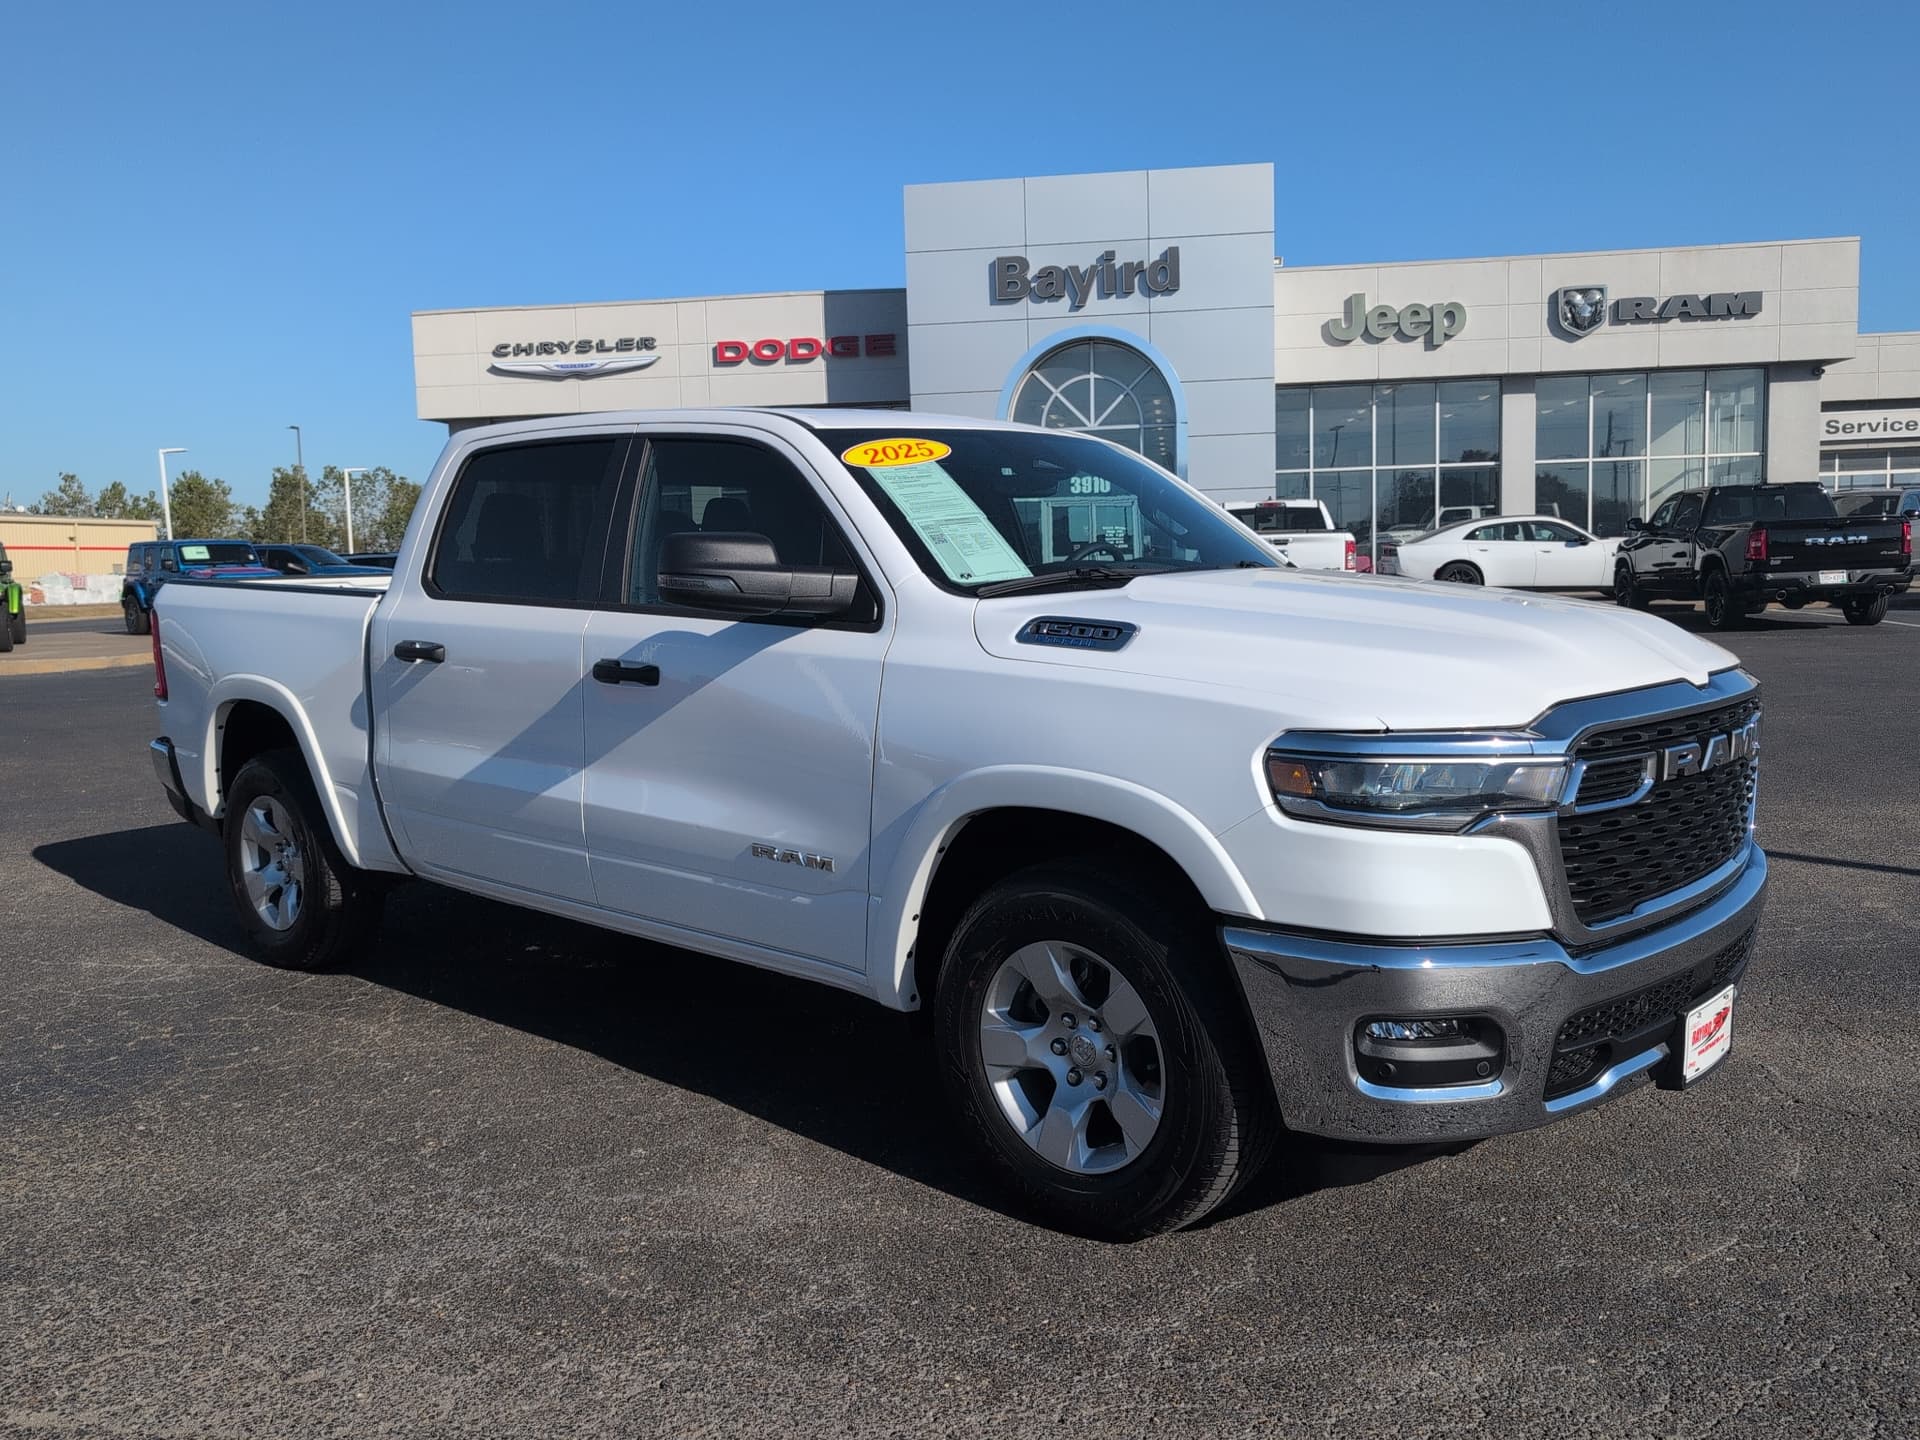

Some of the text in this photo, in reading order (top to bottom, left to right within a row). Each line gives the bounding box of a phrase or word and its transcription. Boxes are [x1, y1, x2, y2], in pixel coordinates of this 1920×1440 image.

[996, 246, 1180, 306] Bayird
[1618, 290, 1763, 321] RAM
[1328, 292, 1467, 346] Jeep
[492, 336, 657, 359] CHRYSLER
[716, 333, 896, 363] DODGE
[1824, 416, 1919, 435] Service
[863, 442, 935, 464] 2025
[1070, 475, 1111, 494] 3910
[1804, 535, 1868, 546] RAM
[1029, 621, 1121, 641] 1500
[1663, 717, 1759, 781] RAM
[751, 842, 836, 873] RAM
